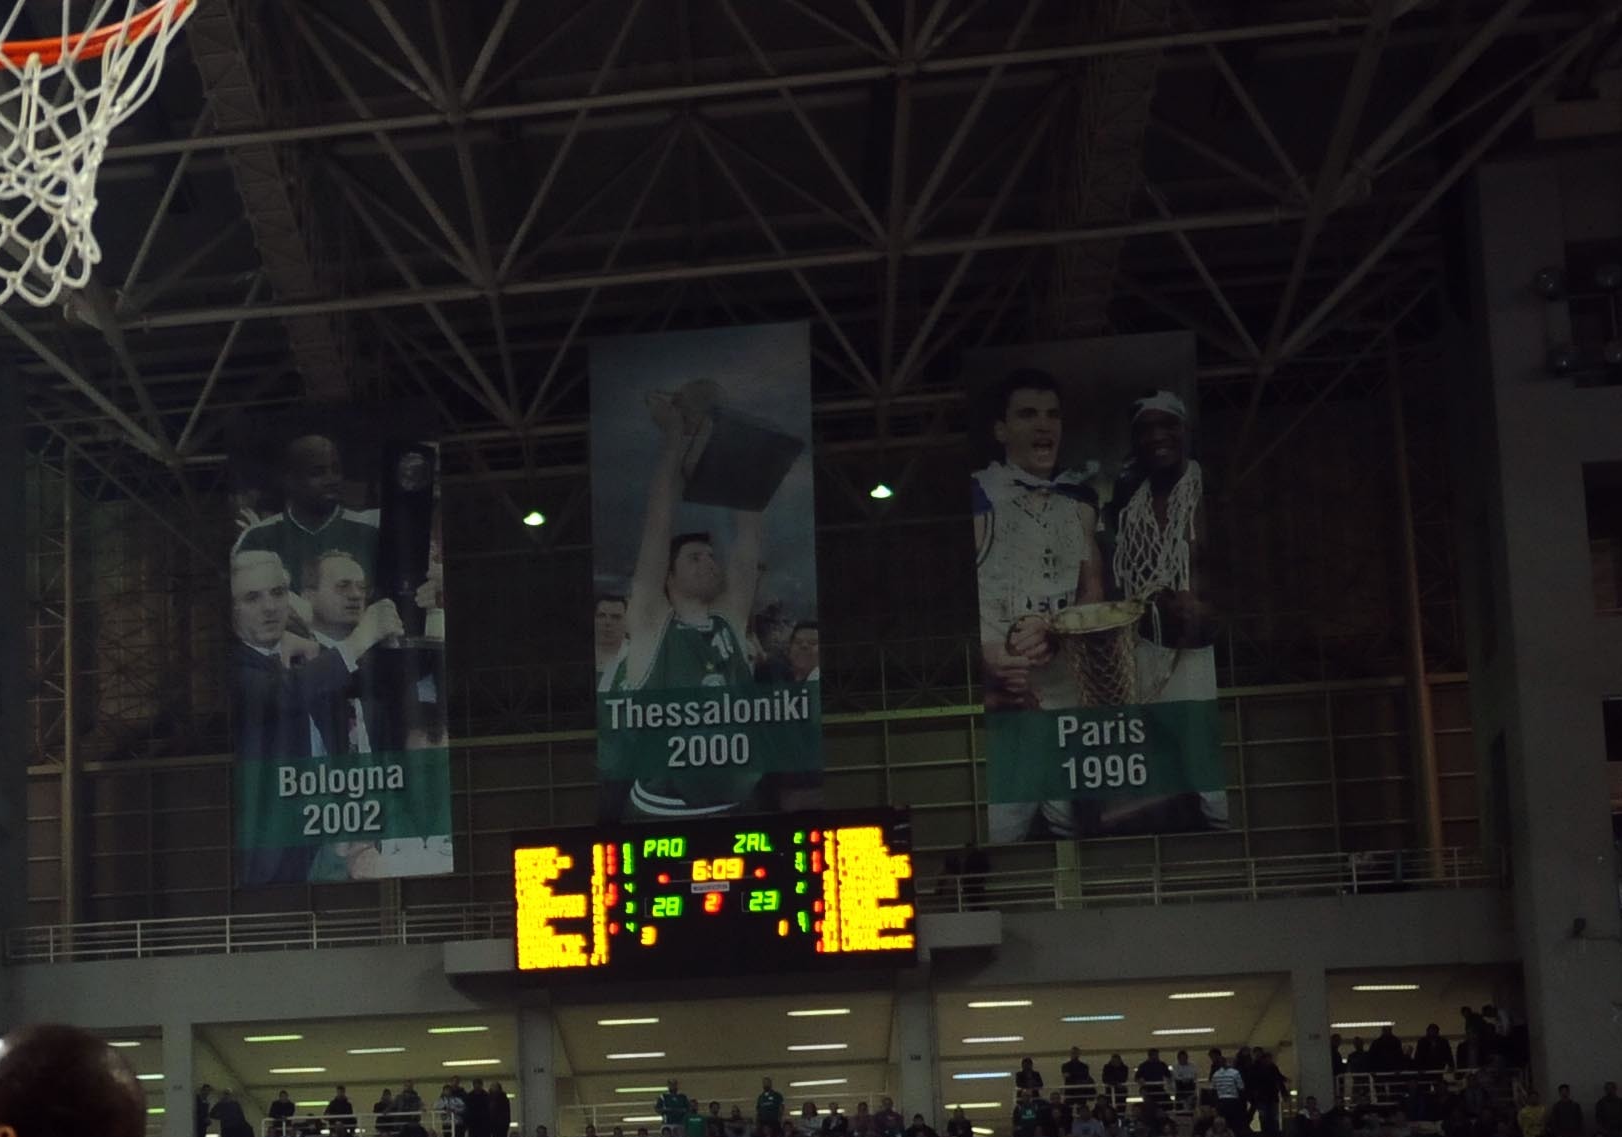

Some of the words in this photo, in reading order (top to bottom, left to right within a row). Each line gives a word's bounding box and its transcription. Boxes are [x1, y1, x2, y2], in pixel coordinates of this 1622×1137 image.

[605, 689, 809, 729] Thessaloniki
[1057, 713, 1146, 747] Paris
[667, 733, 750, 767] 2000
[279, 764, 404, 798] Bologna
[1061, 754, 1147, 790] 1996
[303, 800, 381, 836] 2002
[643, 838, 684, 858] PAO
[733, 833, 772, 853] ZAL
[692, 857, 744, 881] 6:09
[652, 896, 682, 917] 28
[749, 890, 779, 911] 23
